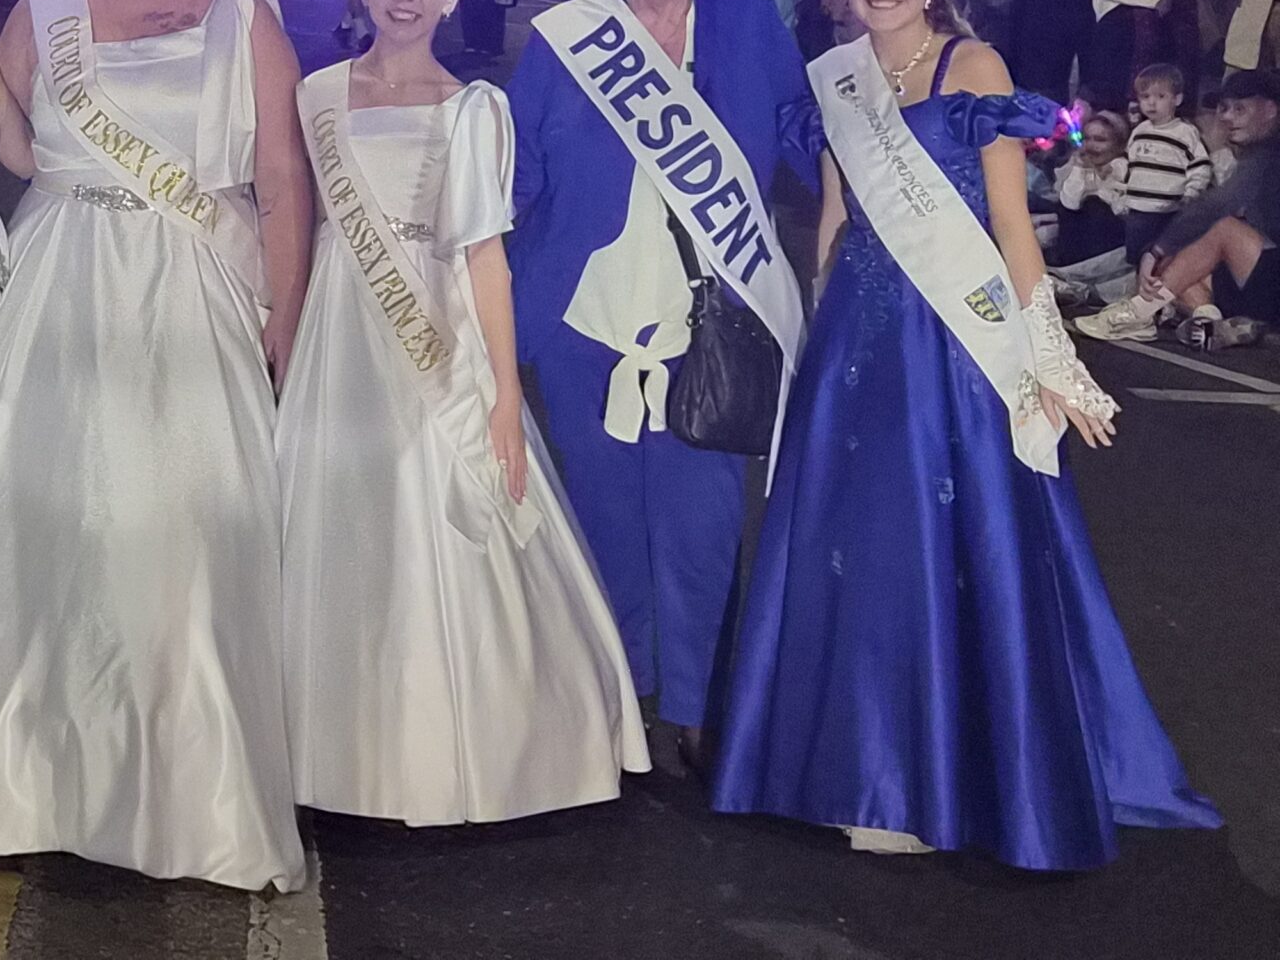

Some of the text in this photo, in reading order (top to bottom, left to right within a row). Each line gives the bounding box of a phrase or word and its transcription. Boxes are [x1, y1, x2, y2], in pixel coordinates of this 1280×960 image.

[46, 15, 82, 86] COURT
[57, 82, 93, 118] OF
[568, 15, 773, 286] PRESIDENT
[891, 154, 939, 214] PRINCESS
[148, 161, 222, 235] QUEEN
[311, 107, 450, 373] COURT OF ESSEX PRINCESS
